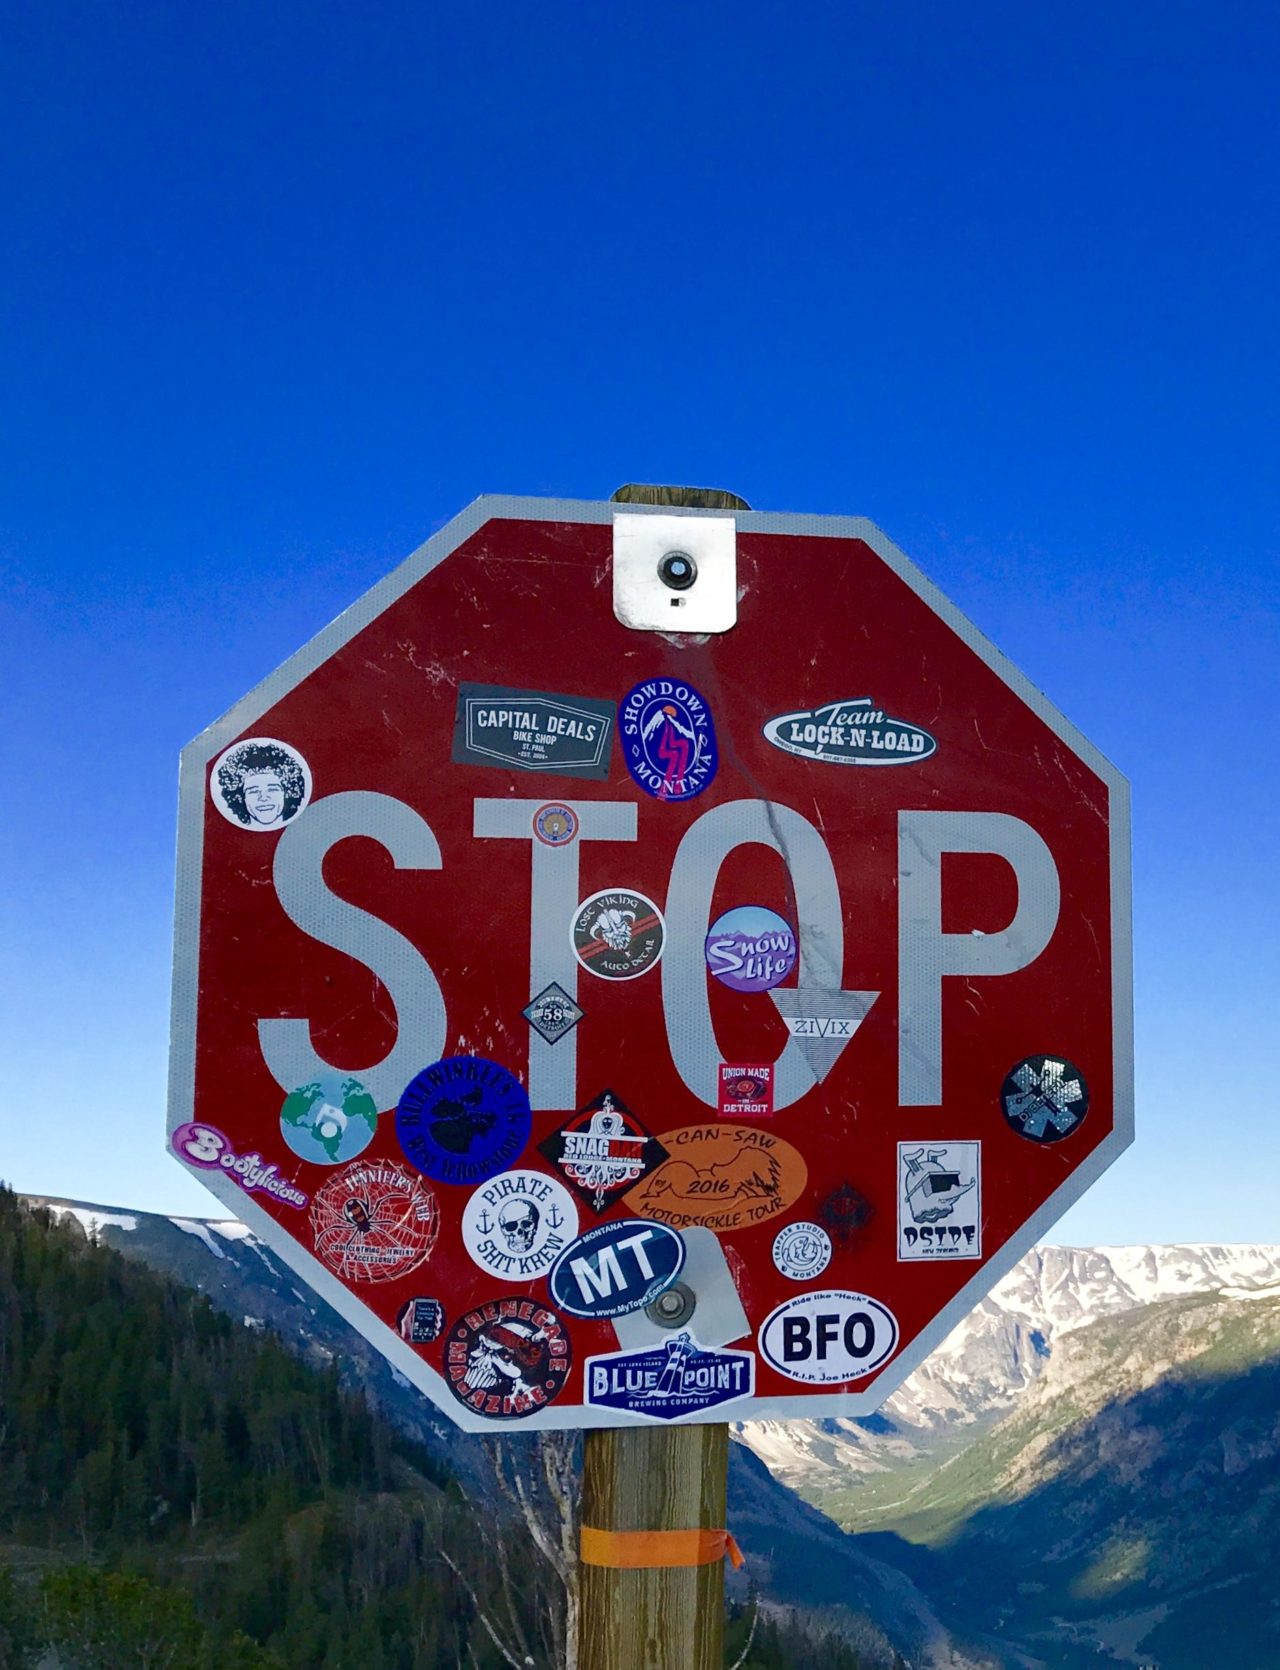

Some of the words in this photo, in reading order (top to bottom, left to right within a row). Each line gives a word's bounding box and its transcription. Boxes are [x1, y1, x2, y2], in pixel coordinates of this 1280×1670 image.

[624, 681, 708, 735] SHOWDOWN
[815, 699, 885, 726] Team
[477, 710, 540, 730] CAPITAL
[547, 715, 597, 742] DEALS
[513, 730, 533, 742] BIKE
[535, 733, 557, 745] SHOP
[790, 723, 925, 753] LOCK-N-LOAD
[531, 744, 545, 752] PAUL
[634, 754, 712, 794] MONTANA
[597, 895, 639, 909] VIKING
[257, 790, 1061, 1117] STOP
[709, 935, 790, 976] Snow
[746, 956, 787, 981] Life
[543, 1008, 563, 1021] 58
[795, 1018, 850, 1038] ZIVIX
[722, 1067, 746, 1080] UNION
[747, 1067, 770, 1081] MADE
[723, 1104, 768, 1113] DETROIT
[564, 1136, 609, 1156] SNAG
[185, 1126, 306, 1206] Bootylicious
[344, 1169, 412, 1193] JENNIFER'S
[481, 1177, 553, 1207] PIRATE
[687, 1179, 731, 1194] 2016
[640, 1202, 742, 1228] MOTORSICKLE
[747, 1196, 787, 1221] TOUR
[582, 1221, 623, 1243] MONTANA
[774, 1228, 792, 1261] TRAPPER
[796, 1224, 825, 1238] STUDIO
[477, 1239, 516, 1273] SHIT
[518, 1232, 564, 1274] KREW
[570, 1230, 655, 1305] MT
[792, 1257, 828, 1278] MONTANA
[596, 1284, 665, 1316] www.MyTopo.com
[791, 1296, 811, 1307] Ride
[464, 1300, 568, 1372] RENEGADE
[783, 1312, 875, 1362] BFO
[448, 1341, 547, 1414] MAGAZINE
[593, 1366, 658, 1397] BLUE
[684, 1361, 745, 1390] POINT
[820, 1372, 839, 1381] Joe
[842, 1367, 867, 1379] Heck
[628, 1399, 667, 1408] BREWING
[670, 1397, 709, 1406] COMPANY
